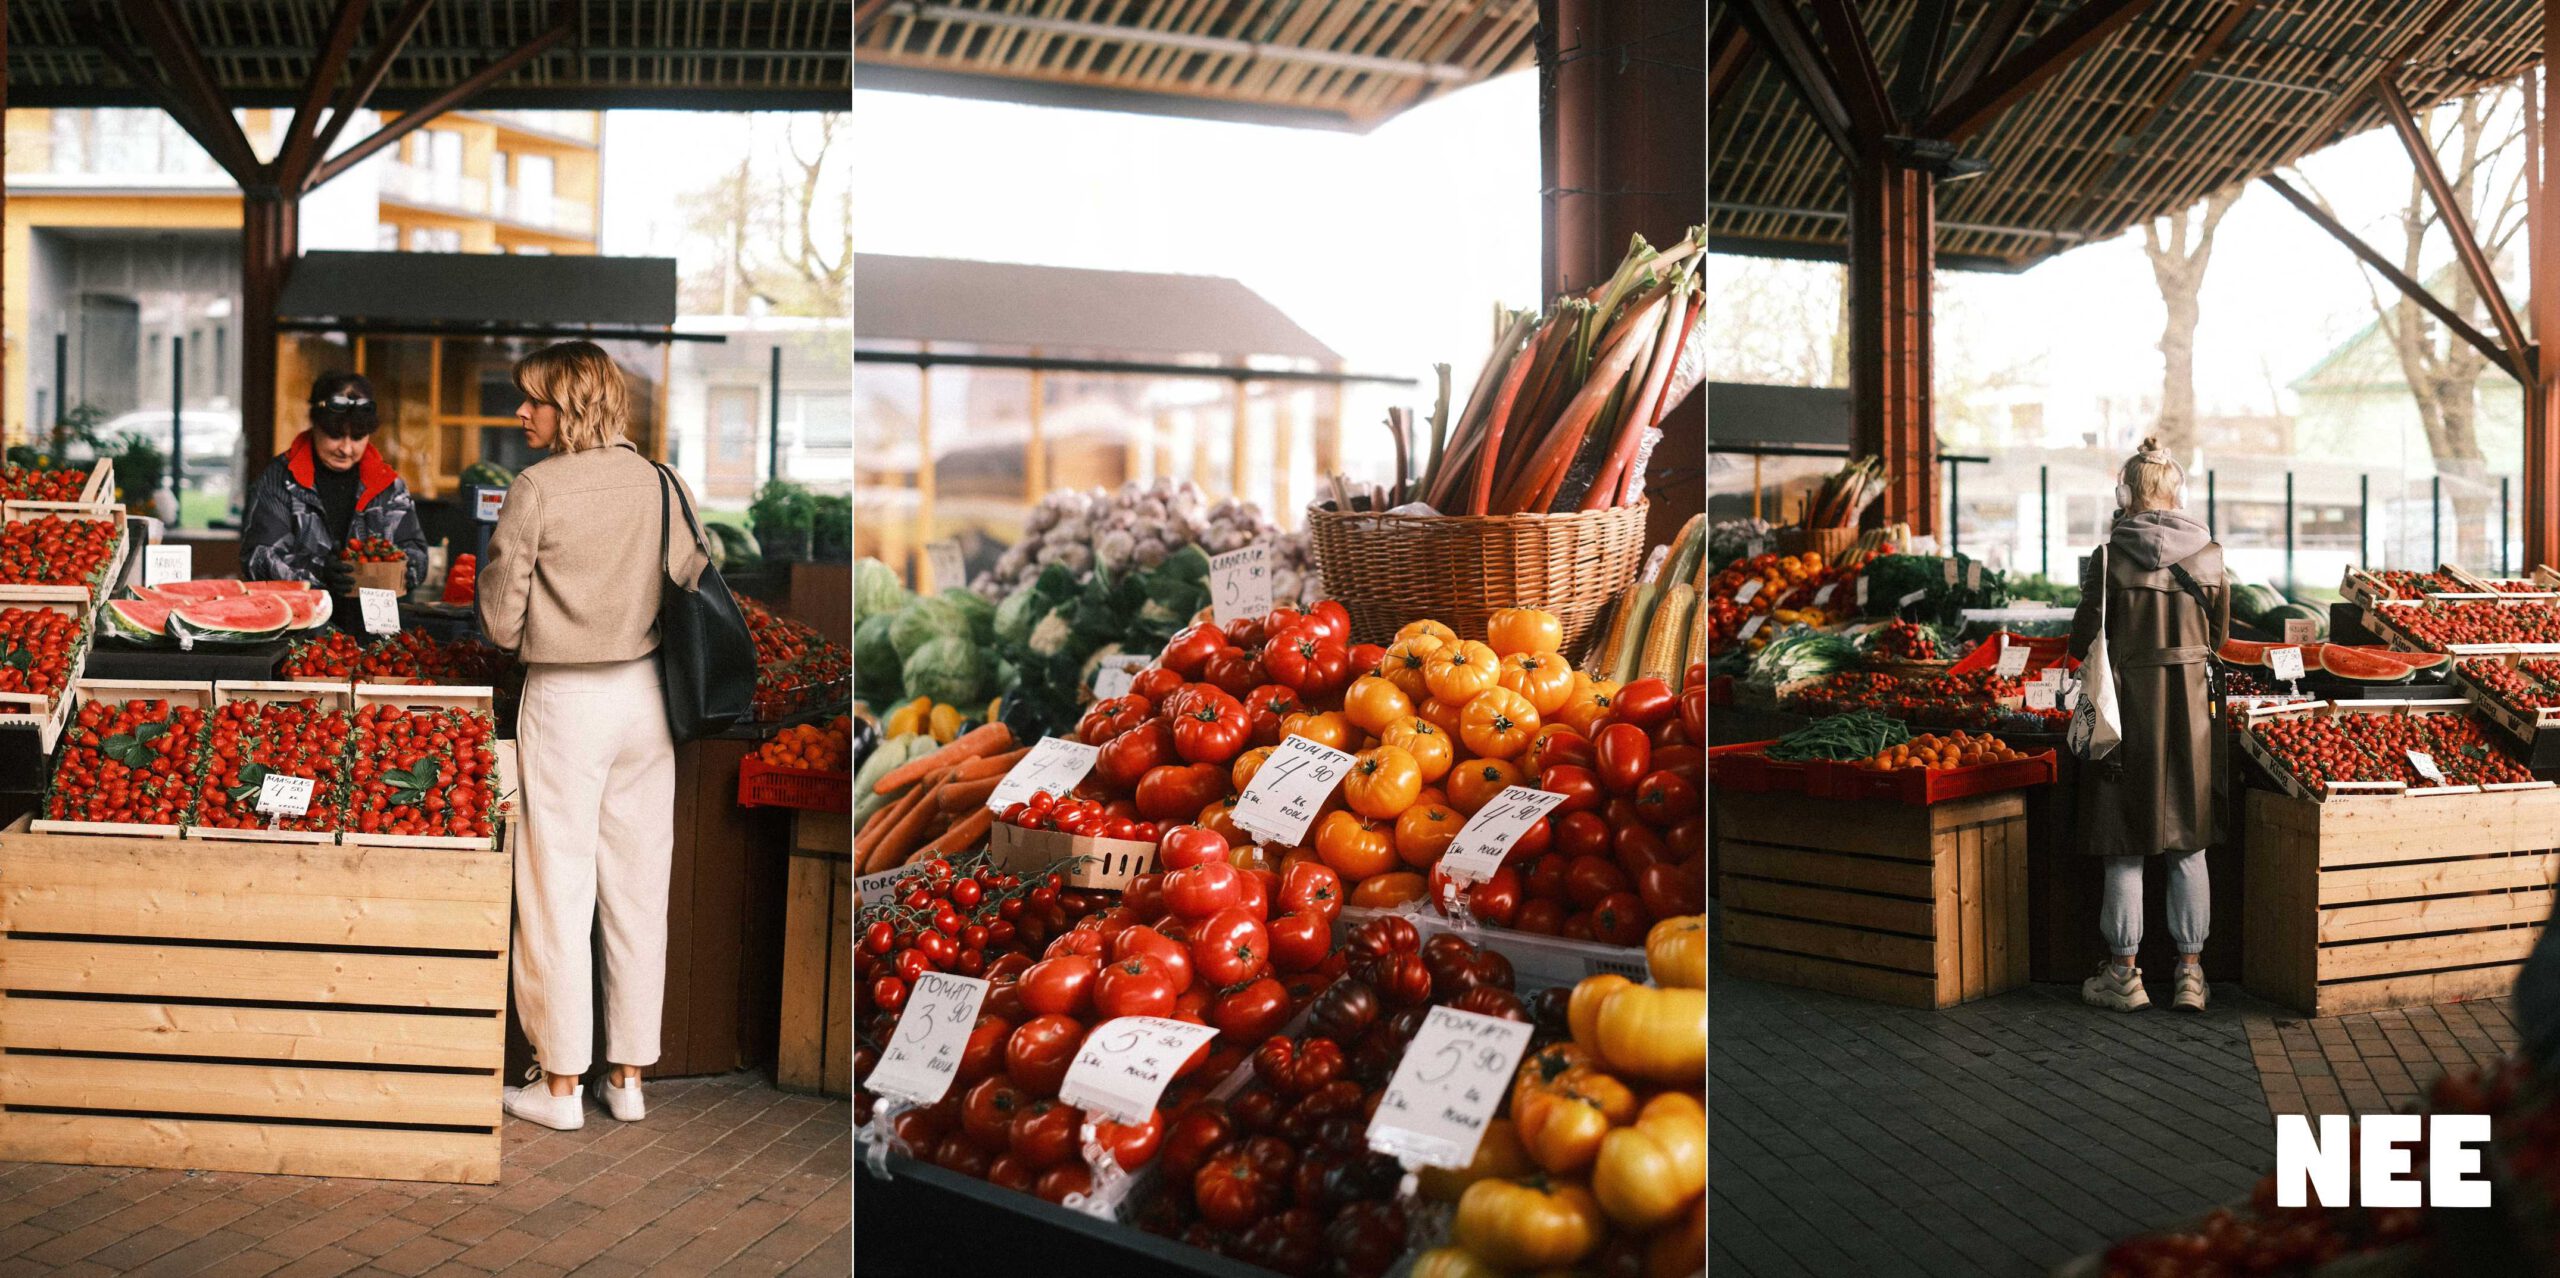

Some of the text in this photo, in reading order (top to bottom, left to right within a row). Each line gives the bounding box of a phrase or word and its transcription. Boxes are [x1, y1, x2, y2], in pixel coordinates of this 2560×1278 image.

[1287, 736, 1348, 764] TOMAT
[1309, 765, 1335, 783] 90
[1504, 788, 1562, 805] TOMAT
[1511, 805, 1541, 820] 90
[919, 974, 978, 1002] TOMAT
[947, 1001, 973, 1023] 90
[1431, 1010, 1513, 1039] TOMAT
[1157, 1035, 1184, 1048] 90
[1474, 1046, 1507, 1073] 90
